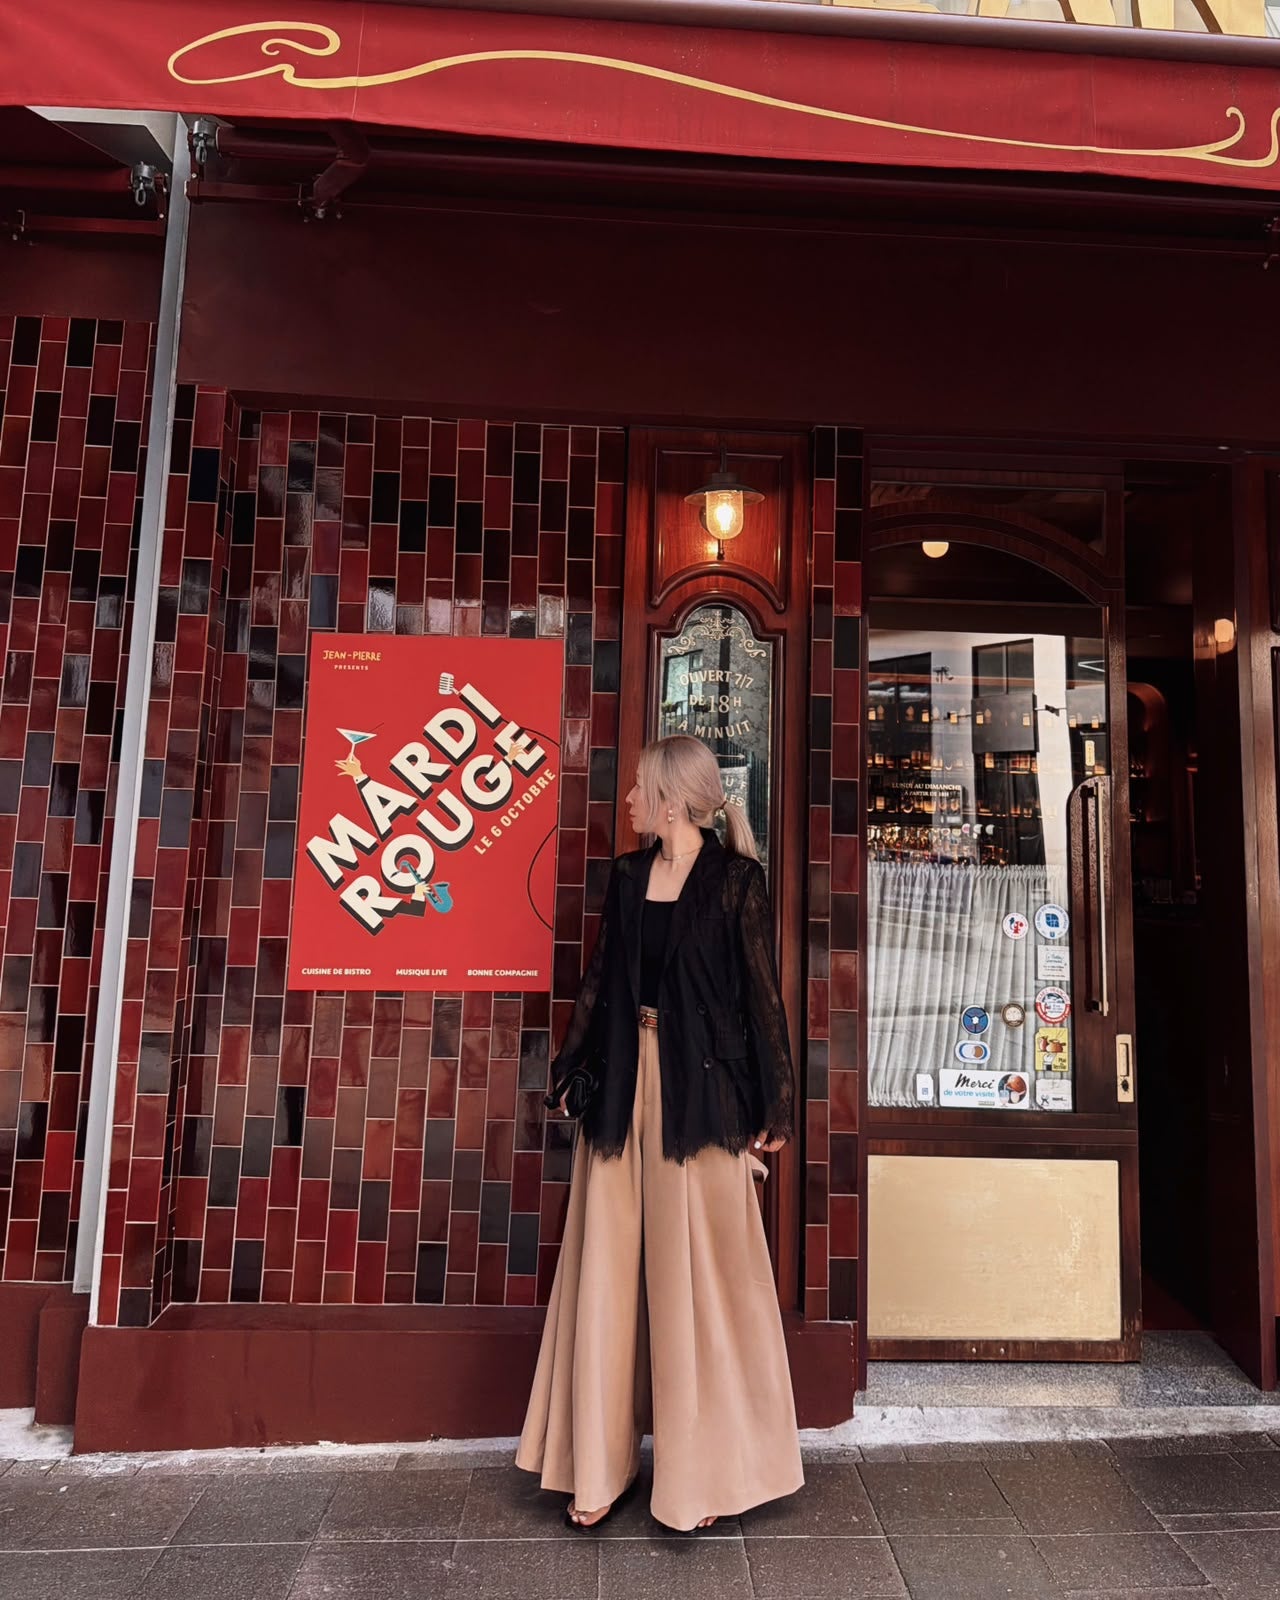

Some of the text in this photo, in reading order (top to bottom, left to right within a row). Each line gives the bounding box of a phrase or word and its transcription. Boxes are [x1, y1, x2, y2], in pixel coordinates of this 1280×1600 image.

[322, 649, 382, 662] JEAN-PIERRE
[679, 669, 754, 689] OUVERT 7/7
[689, 694, 706, 706] DE
[694, 719, 751, 739] MINUIT
[306, 682, 502, 889] MARDI
[925, 783, 962, 791] DIMANCHE
[473, 768, 556, 855] LE 6 OCTOBRE
[340, 720, 546, 936] ROUGE
[301, 967, 372, 976] CUISINE DE BISTRO
[395, 968, 448, 977] MUSIQUE LIVE
[494, 969, 539, 977] COMPAGNIE
[954, 1072, 995, 1090] Merci
[943, 1088, 996, 1098] de votre visite
